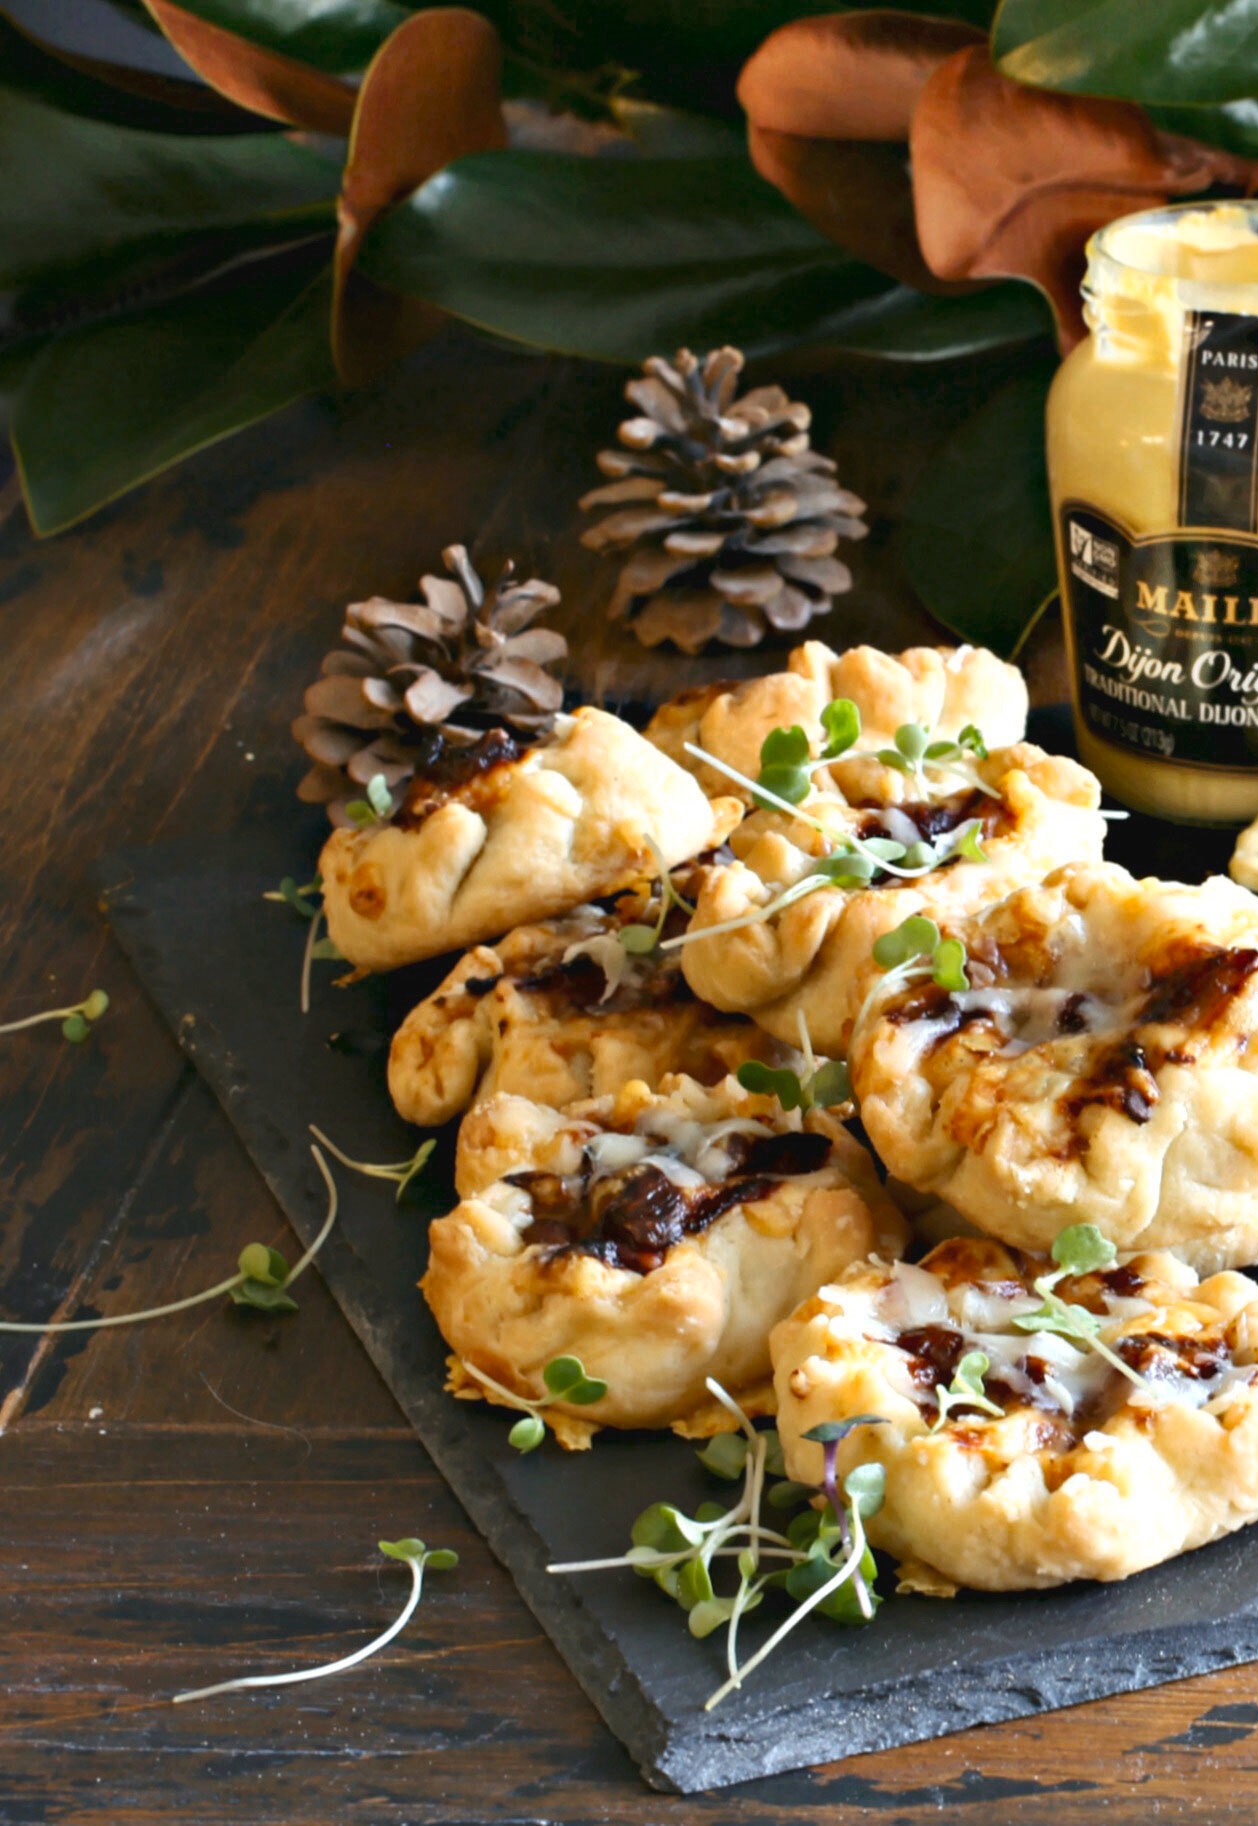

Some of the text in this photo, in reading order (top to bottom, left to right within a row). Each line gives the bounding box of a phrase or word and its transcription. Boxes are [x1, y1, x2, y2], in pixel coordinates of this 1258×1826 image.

[1202, 350, 1258, 369] PARIS
[1197, 430, 1248, 449] 1747
[1094, 624, 1185, 684] Dijon
